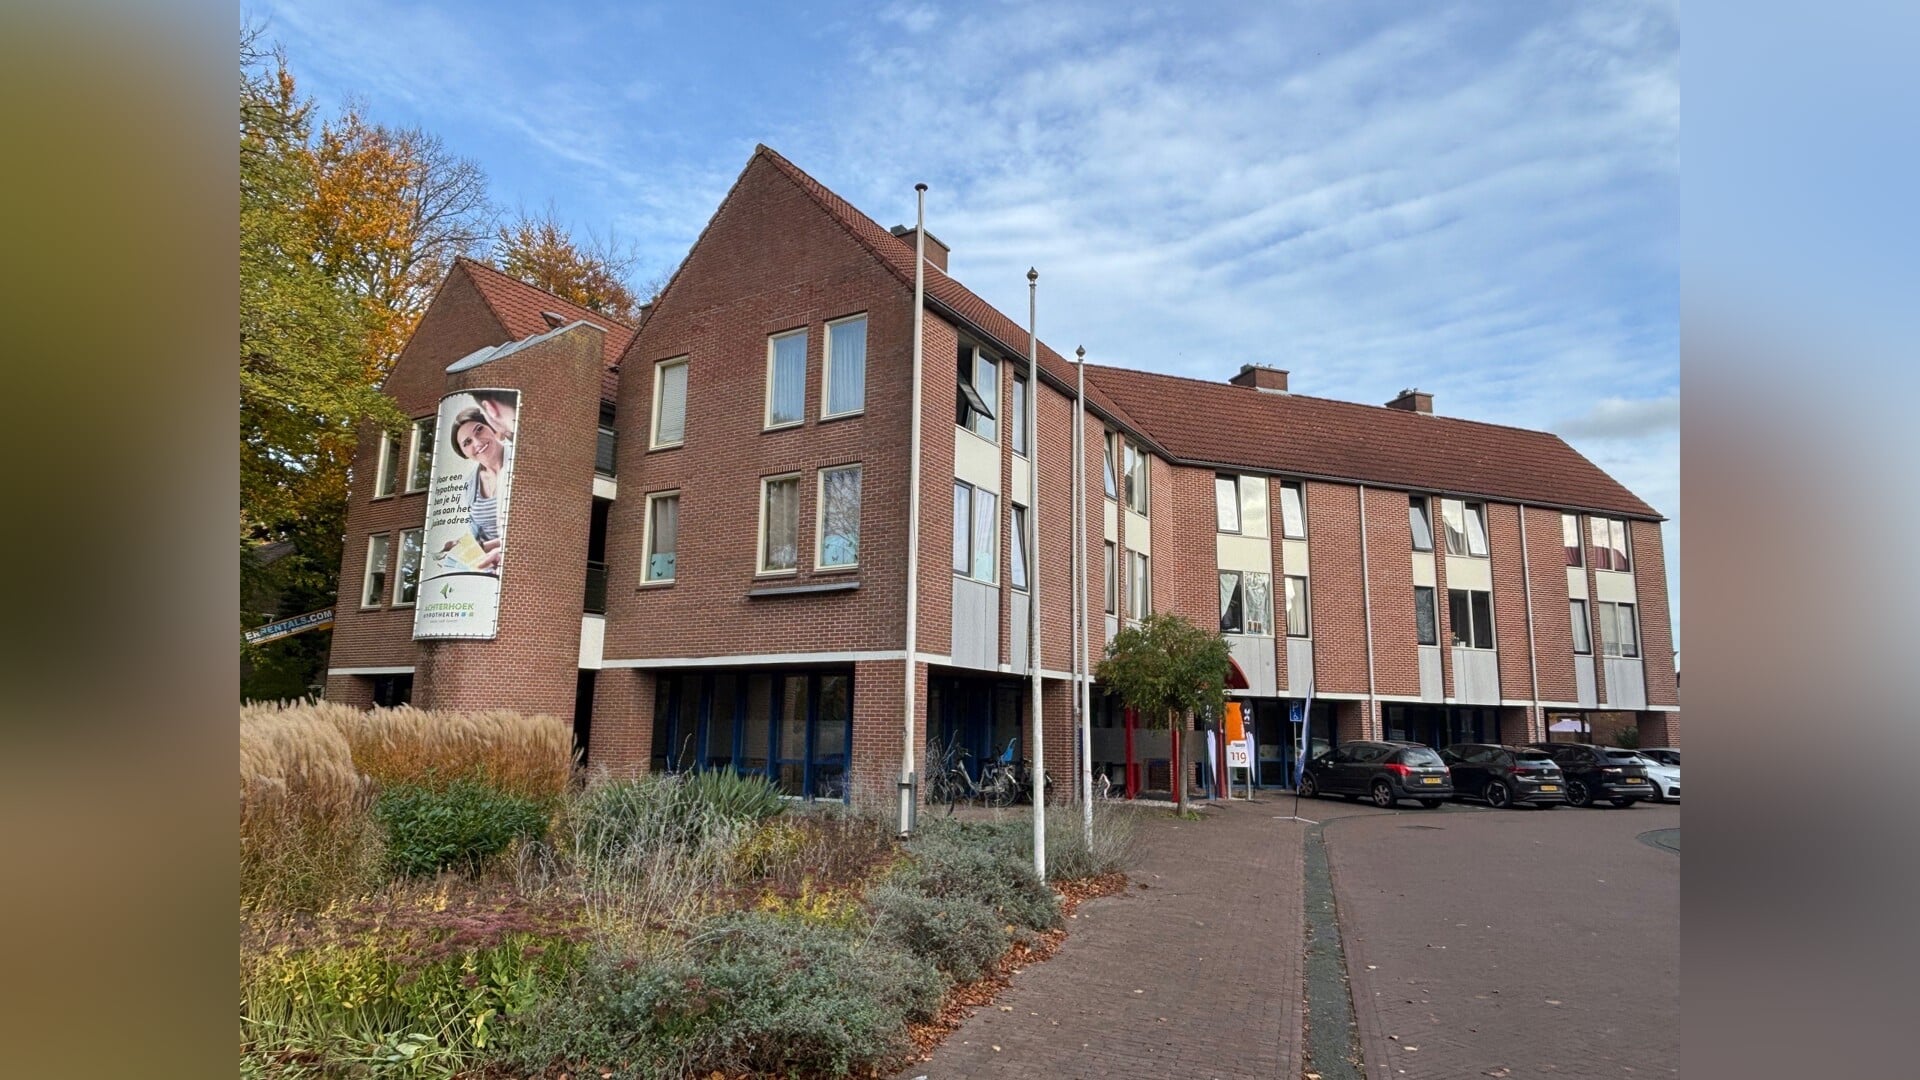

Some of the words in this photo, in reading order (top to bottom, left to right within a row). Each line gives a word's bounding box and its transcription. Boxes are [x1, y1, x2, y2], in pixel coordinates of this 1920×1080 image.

[435, 481, 469, 496] hypotheek
[443, 495, 450, 506] je
[450, 493, 461, 504] bij
[456, 504, 471, 512] het
[1230, 751, 1247, 764] 119
